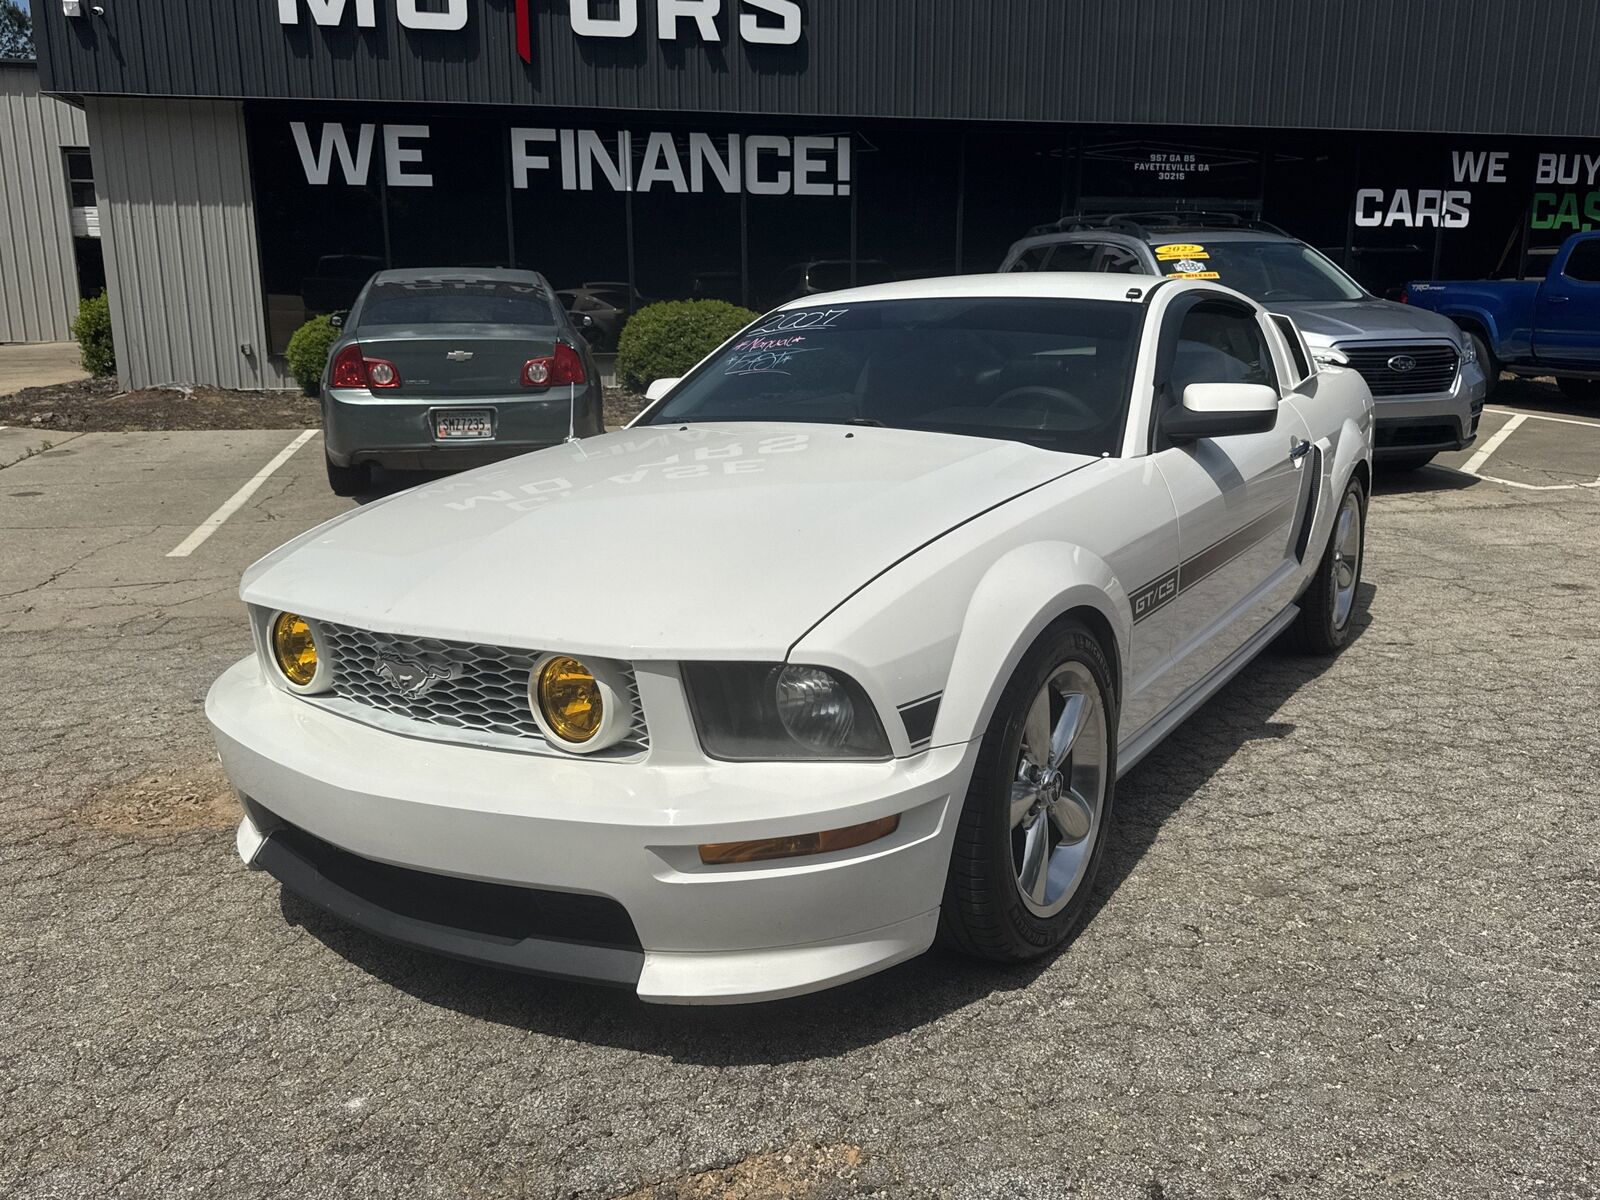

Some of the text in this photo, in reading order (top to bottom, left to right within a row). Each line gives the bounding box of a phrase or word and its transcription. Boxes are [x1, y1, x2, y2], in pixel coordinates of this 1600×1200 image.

[289, 121, 852, 196] WE FINANCE!
[1134, 162, 1210, 172] FAYETTEVILLE GA
[1452, 151, 1600, 185] WE BUY
[1158, 172, 1185, 180] 30215
[1355, 188, 1471, 228] CARS
[1165, 245, 1195, 253] 2022
[750, 309, 849, 333] 2007
[1135, 578, 1175, 614] GT/CS
